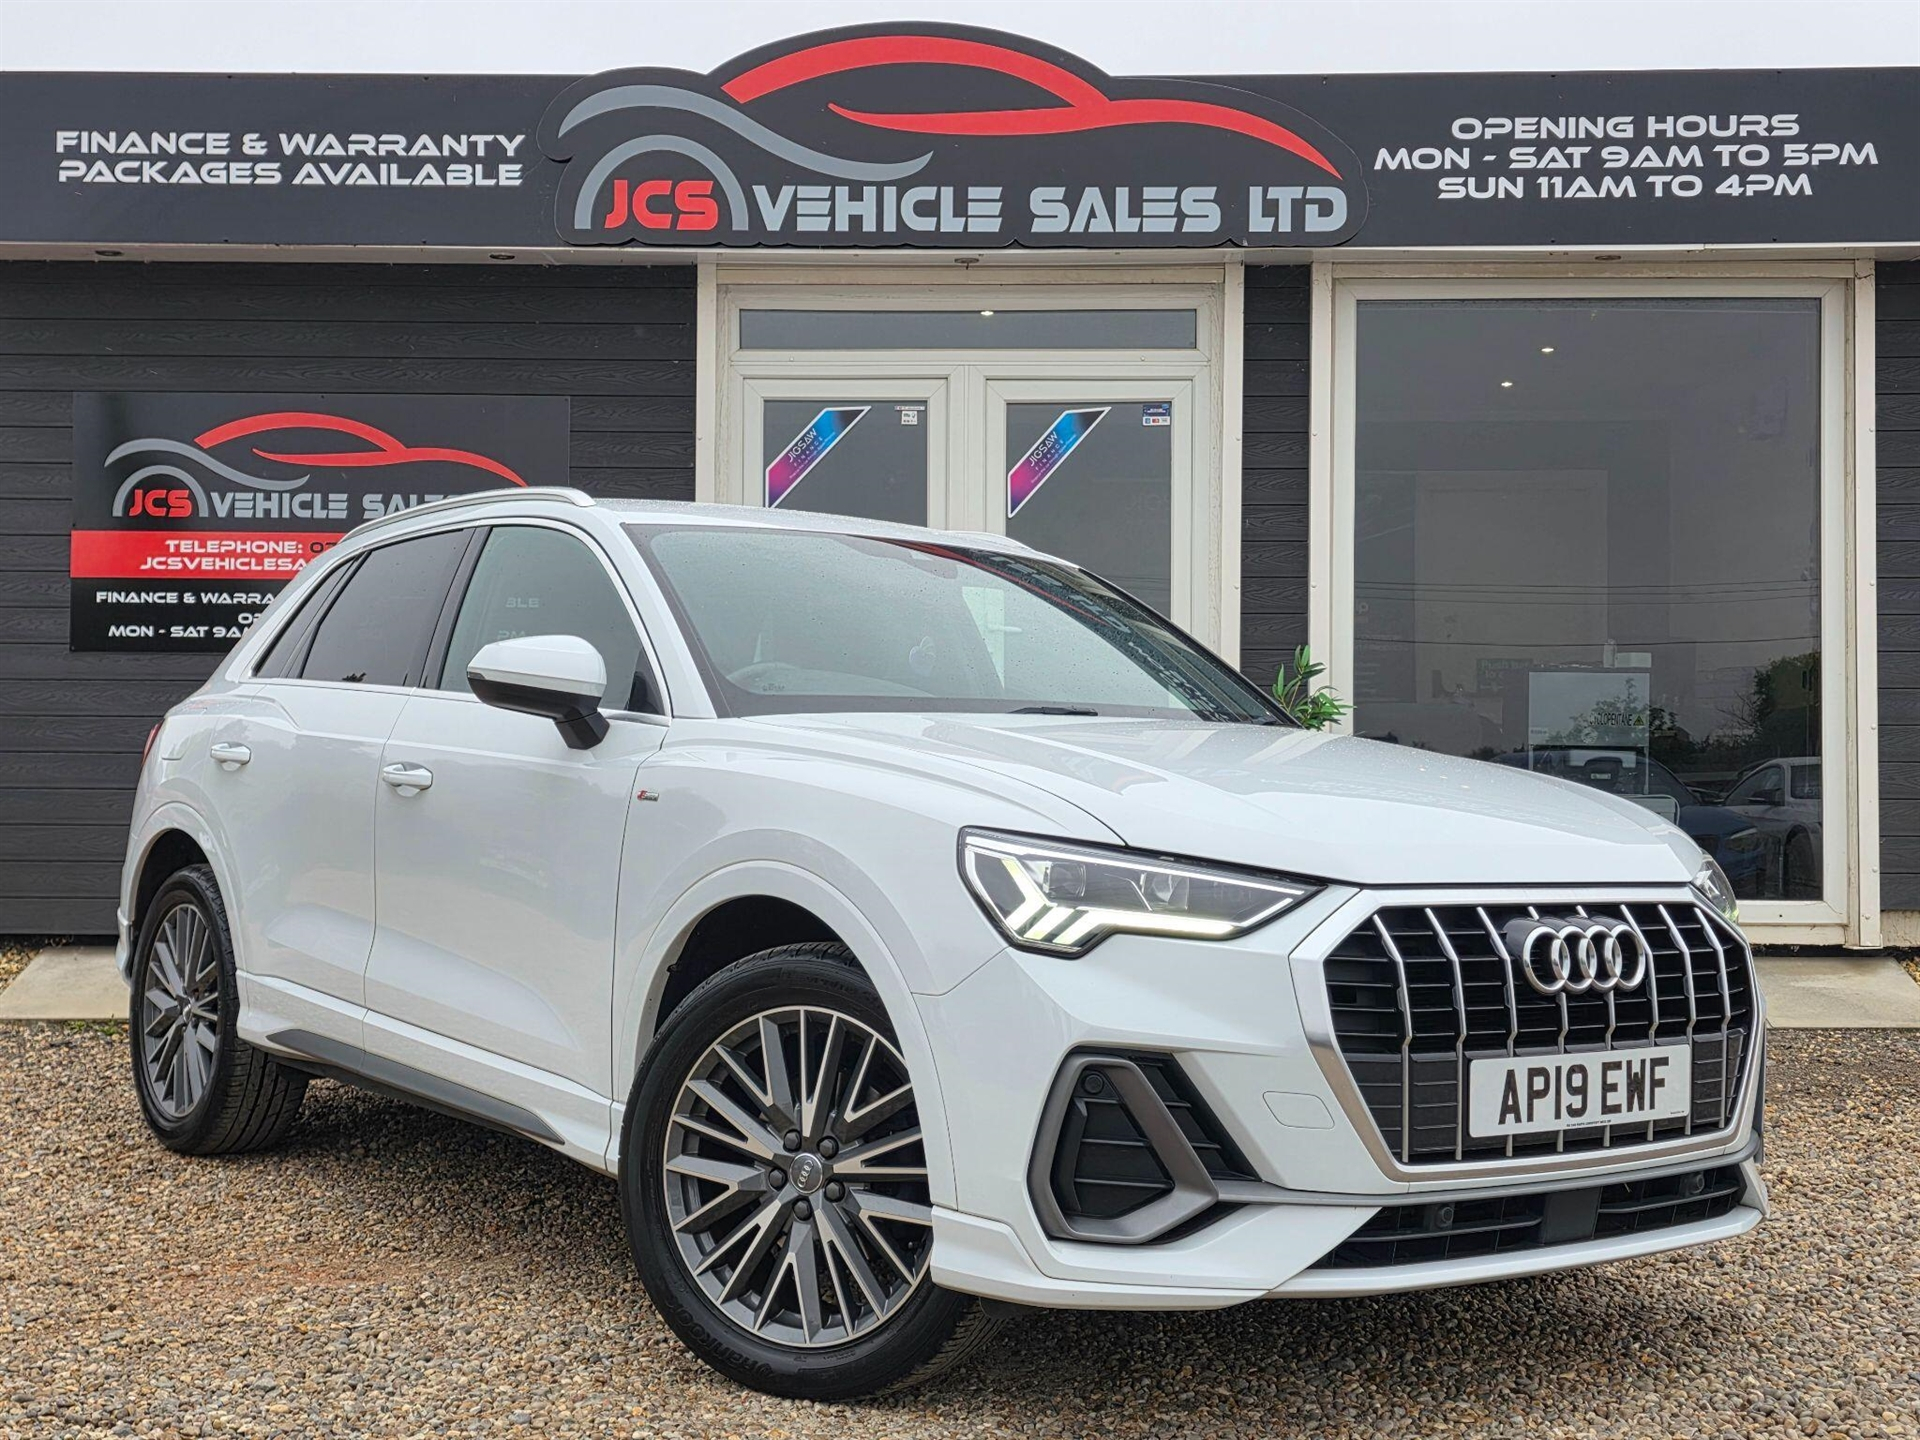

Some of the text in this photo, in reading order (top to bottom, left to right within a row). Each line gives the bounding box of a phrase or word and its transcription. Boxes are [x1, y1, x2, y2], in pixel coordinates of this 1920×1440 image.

[1451, 114, 1800, 139] OPENING HOURS
[56, 131, 525, 157] FINANCE & WARRANTY
[1373, 147, 1470, 170] MON
[1508, 146, 1592, 168] SAT
[1601, 145, 1703, 168] 9AM
[1713, 144, 1770, 167] TO
[1783, 142, 1879, 166] 5PM
[58, 161, 523, 186] PACKAGES AVAILABLE
[1437, 173, 1813, 199] SUN 11AM TO 4PM
[605, 180, 1348, 233] JCS VEHICLE SALES LTD
[787, 427, 817, 463] JIGSAW
[1028, 430, 1058, 467] JIGSAW
[129, 489, 192, 518] JCS
[211, 492, 348, 519] VEHICLE
[165, 540, 302, 554] TELEPHONE:
[96, 592, 178, 604] FINANCE
[184, 592, 195, 604] &
[108, 625, 154, 637] MON
[170, 626, 209, 637] SAT
[1497, 1056, 1670, 1125] AP19 EWF
